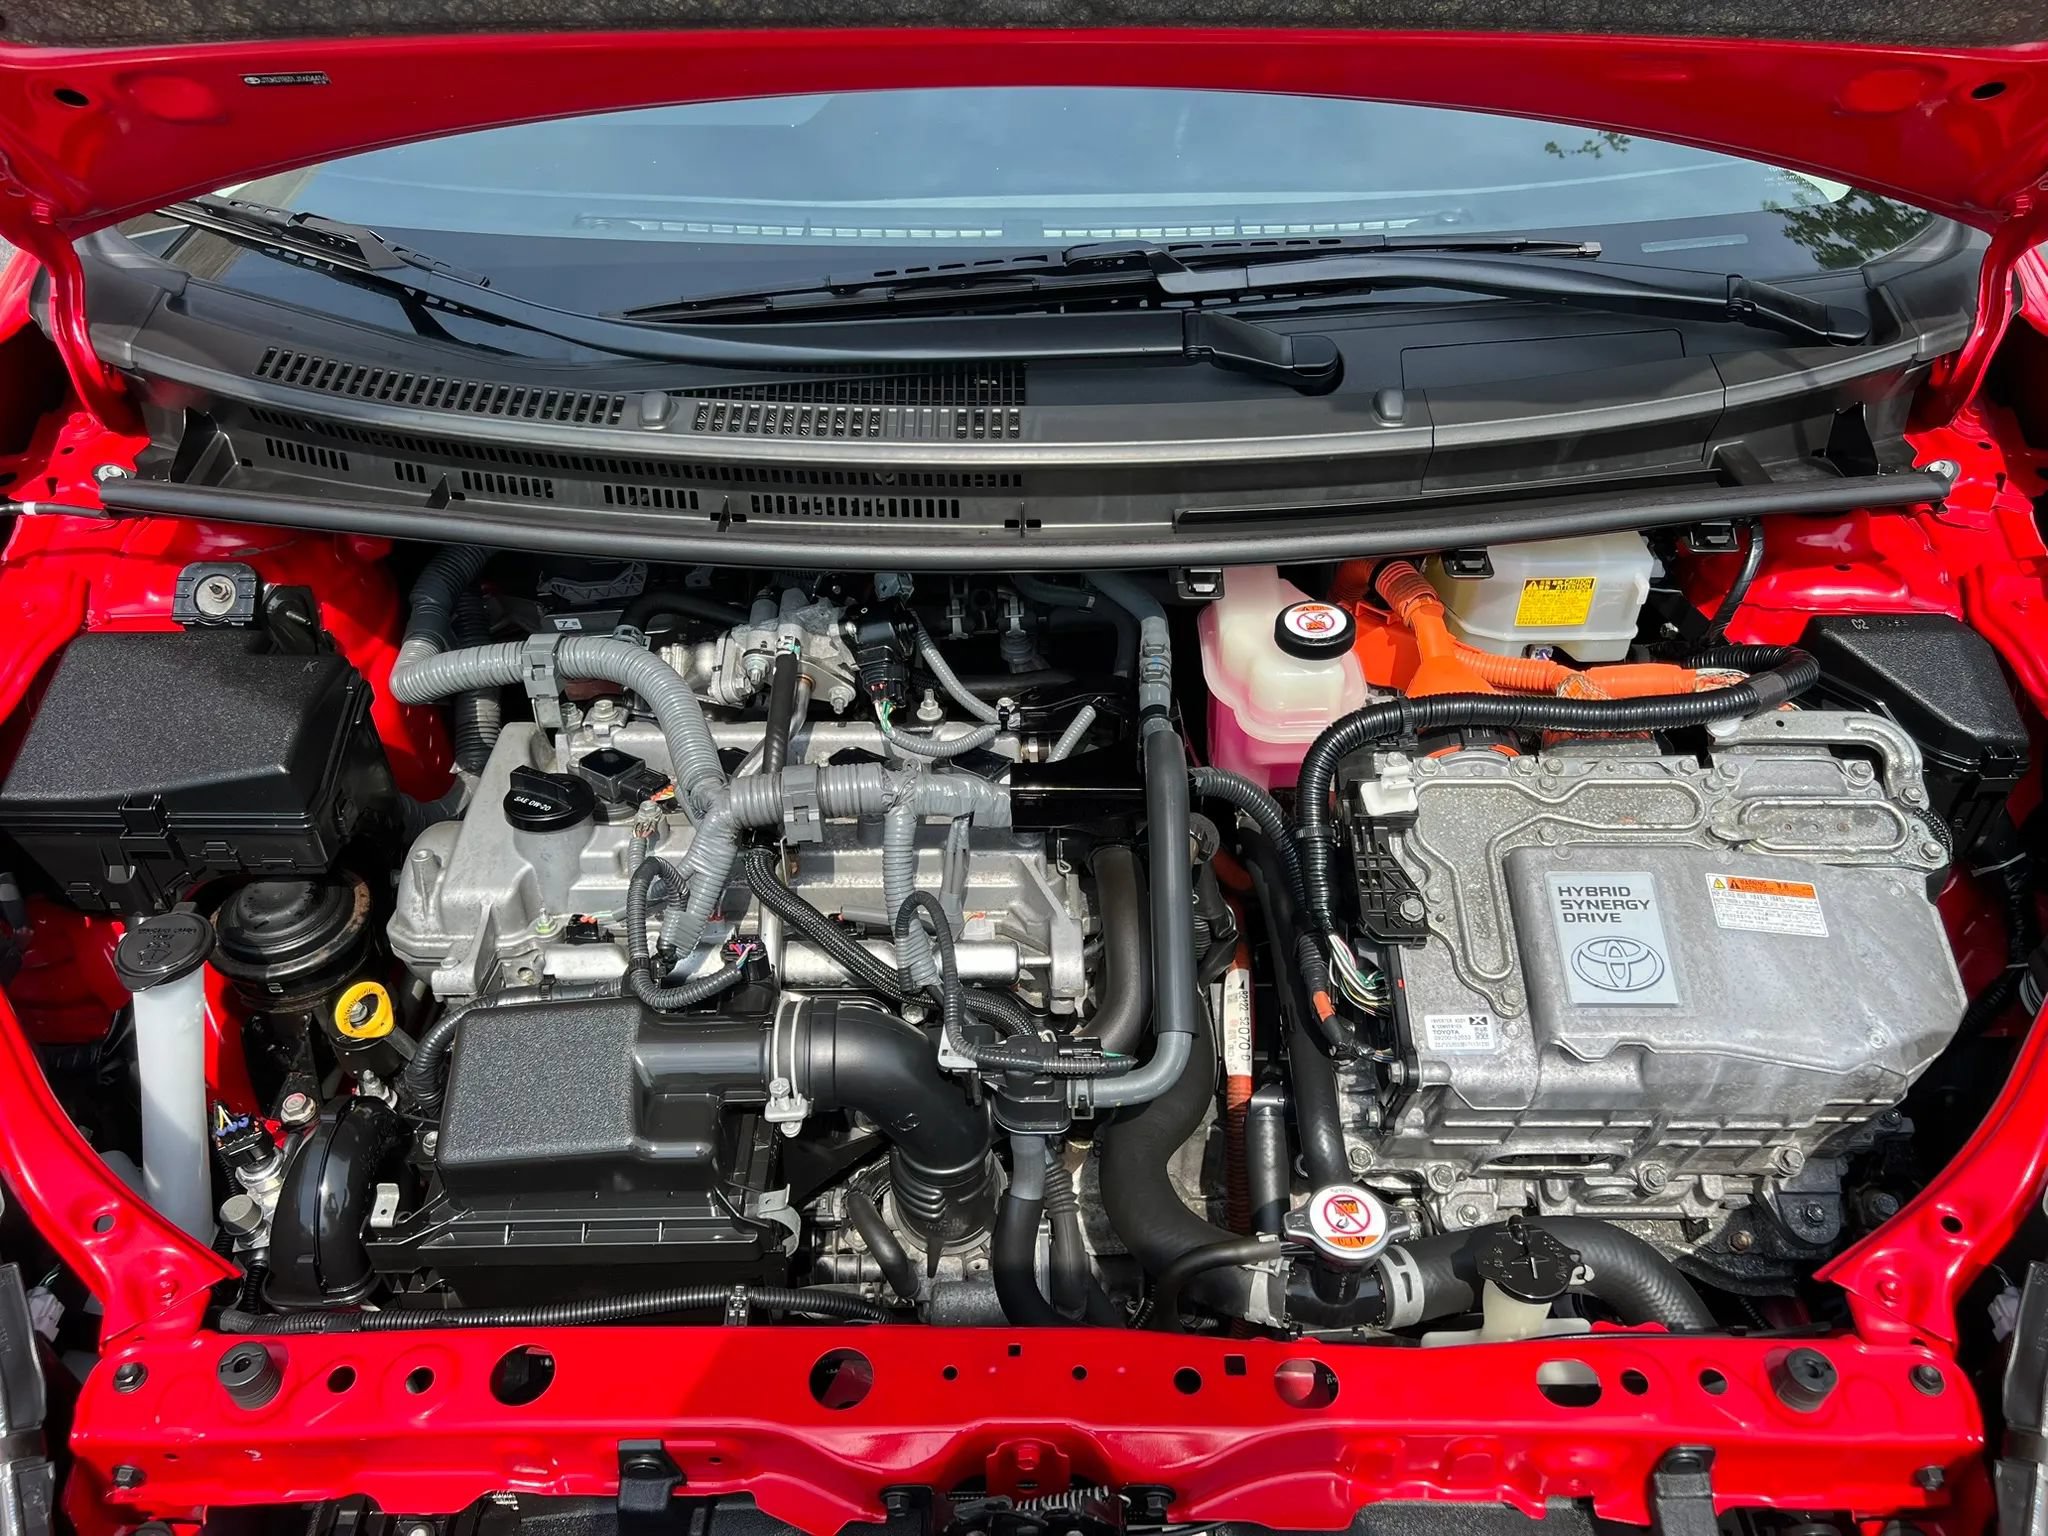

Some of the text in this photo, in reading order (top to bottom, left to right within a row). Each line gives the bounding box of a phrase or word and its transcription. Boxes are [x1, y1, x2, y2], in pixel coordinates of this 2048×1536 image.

[514, 796, 552, 811] SAE 0W-20
[1558, 886, 1631, 897] HYBRID
[1560, 899, 1650, 910] SYNERGY
[1563, 913, 1622, 923] DRIVE
